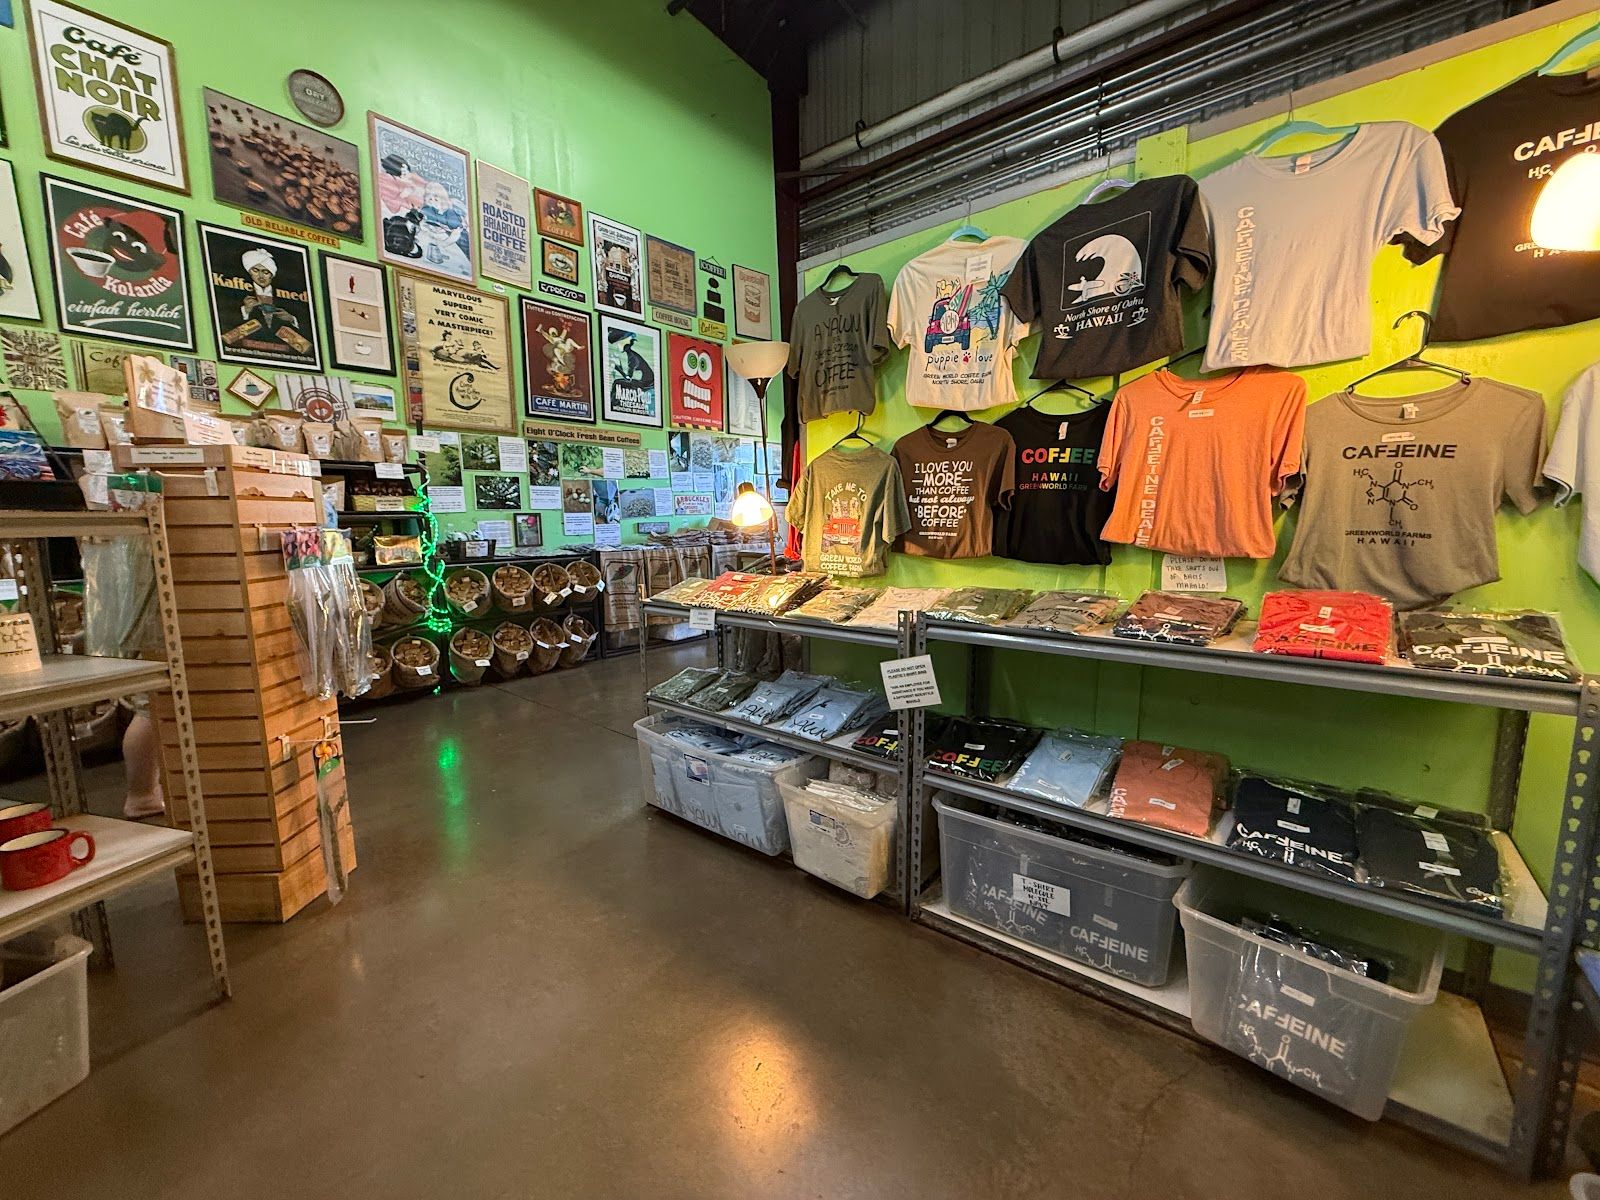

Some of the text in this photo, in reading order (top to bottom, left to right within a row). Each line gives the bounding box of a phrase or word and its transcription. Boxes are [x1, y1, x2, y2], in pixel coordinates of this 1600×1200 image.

[63, 26, 142, 66] Café
[50, 43, 157, 96] CHAT
[55, 66, 162, 122] NOIR
[64, 210, 104, 239] Café
[483, 202, 526, 228] ROASTED
[245, 216, 337, 247] OLD RELIABLE COFFEE
[484, 215, 526, 240] BRIARDALE
[484, 228, 526, 252] COFFEE
[103, 275, 173, 298] Kolanda
[212, 272, 308, 303] Kaffe med
[433, 287, 482, 303] MARVELOUS
[67, 300, 183, 319] einfach herrlich
[443, 300, 473, 311] SUPERB
[1065, 297, 1144, 323] North Shore of Oahu
[434, 309, 483, 324] VERY COMIC
[822, 313, 860, 336] YAWN
[1075, 312, 1123, 331] HAWAII
[437, 320, 493, 336] MASTERPIECE!
[925, 346, 993, 371] puppie love
[560, 400, 588, 411] MARTIN
[527, 427, 640, 444] Eight O'Clock Fresh Bean Coffees
[1021, 448, 1095, 465] COFFEE
[1144, 416, 1165, 495] CAFFEINE
[1342, 444, 1457, 460] CAFFEINE
[914, 460, 973, 473] I LOVE YOU
[923, 472, 963, 487] MORE
[825, 482, 867, 502] TAKE ME TO
[909, 495, 975, 505] but not always
[915, 486, 969, 495] THAN COFFEE
[917, 505, 963, 519] BEFORE
[921, 519, 959, 528] COFFEE
[1401, 531, 1432, 539] FARMS
[821, 563, 847, 571] COFFEE
[1412, 642, 1566, 665] CAFFEINE
[1237, 823, 1345, 864] CAFFEINE
[1070, 925, 1149, 963] CAFFEINE
